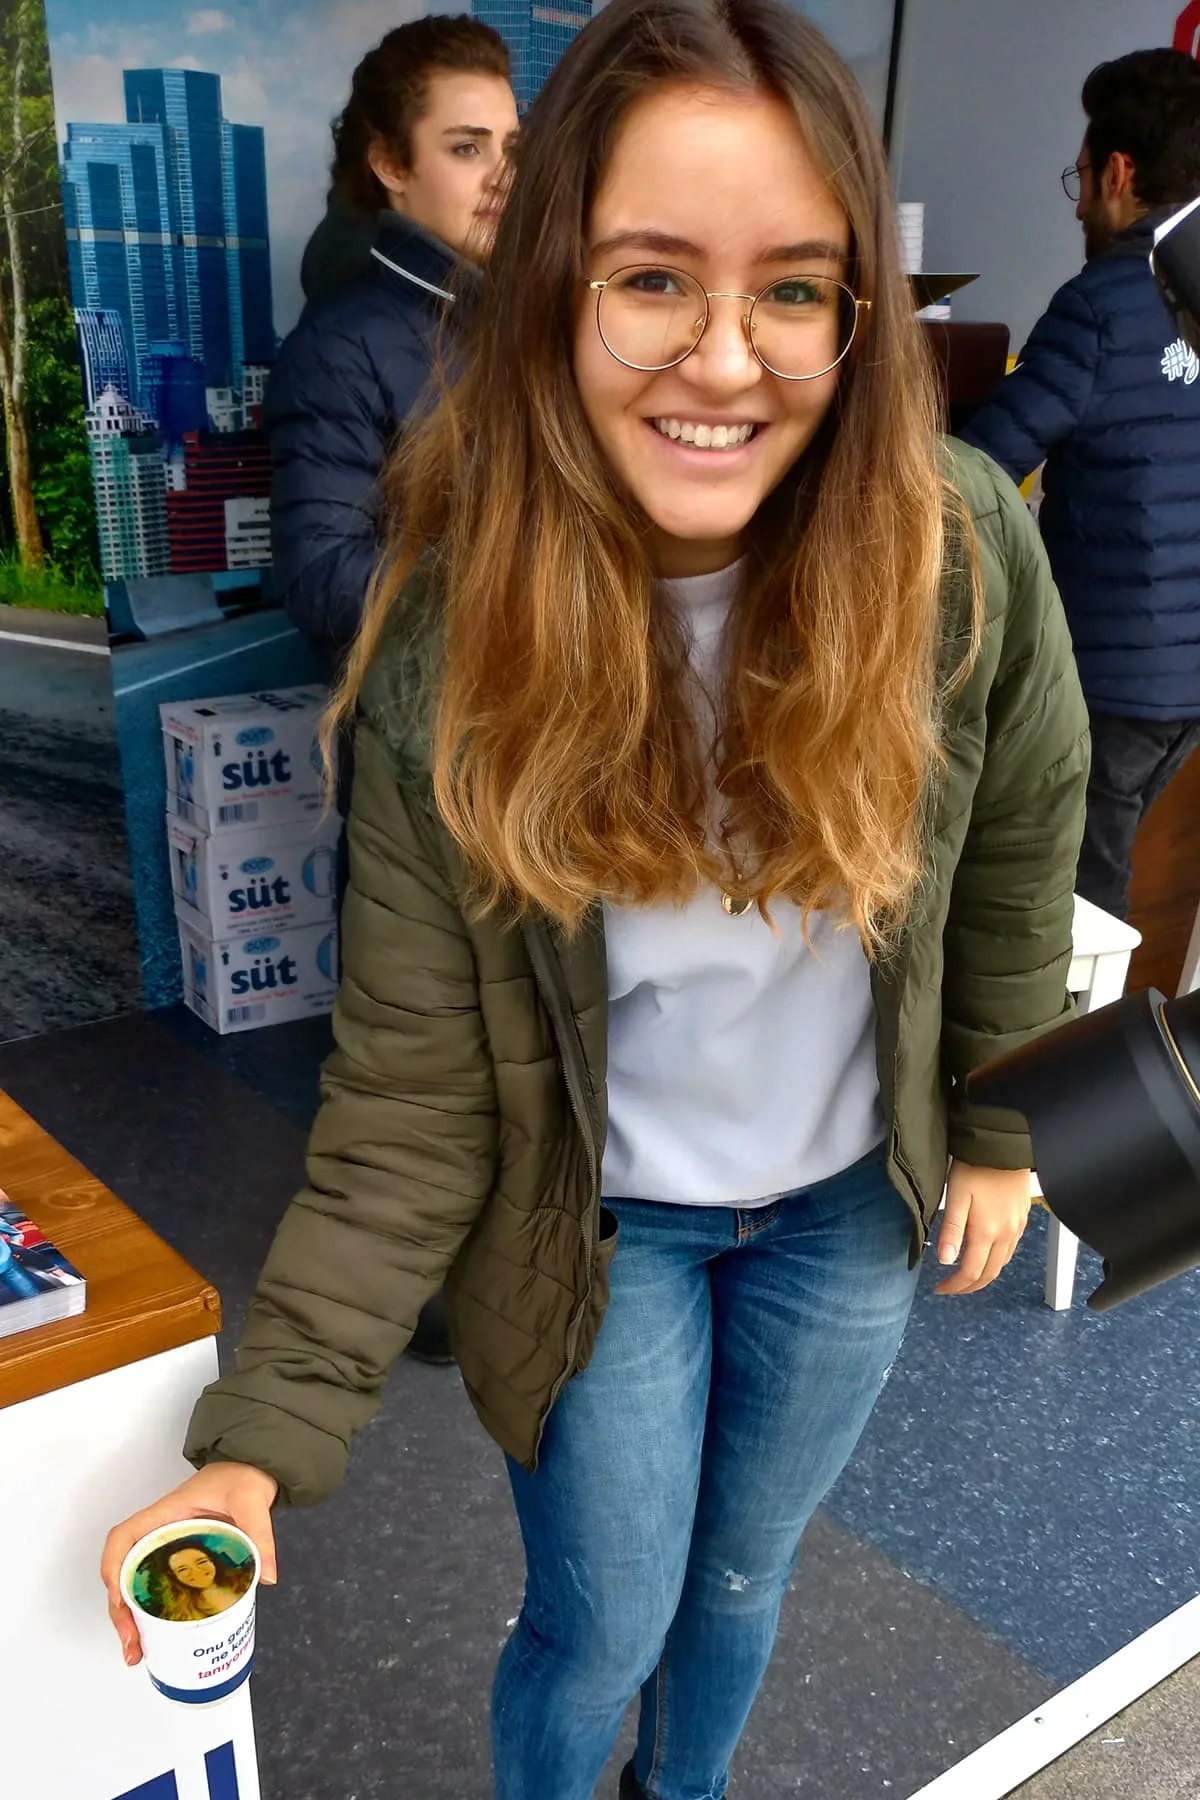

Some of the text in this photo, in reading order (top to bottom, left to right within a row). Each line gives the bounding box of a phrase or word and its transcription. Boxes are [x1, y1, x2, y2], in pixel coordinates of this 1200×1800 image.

[222, 749, 292, 791] süt
[228, 875, 291, 913] süt
[231, 955, 298, 995] süt
[193, 1641, 224, 1657] Onu
[211, 1651, 229, 1664] ne
